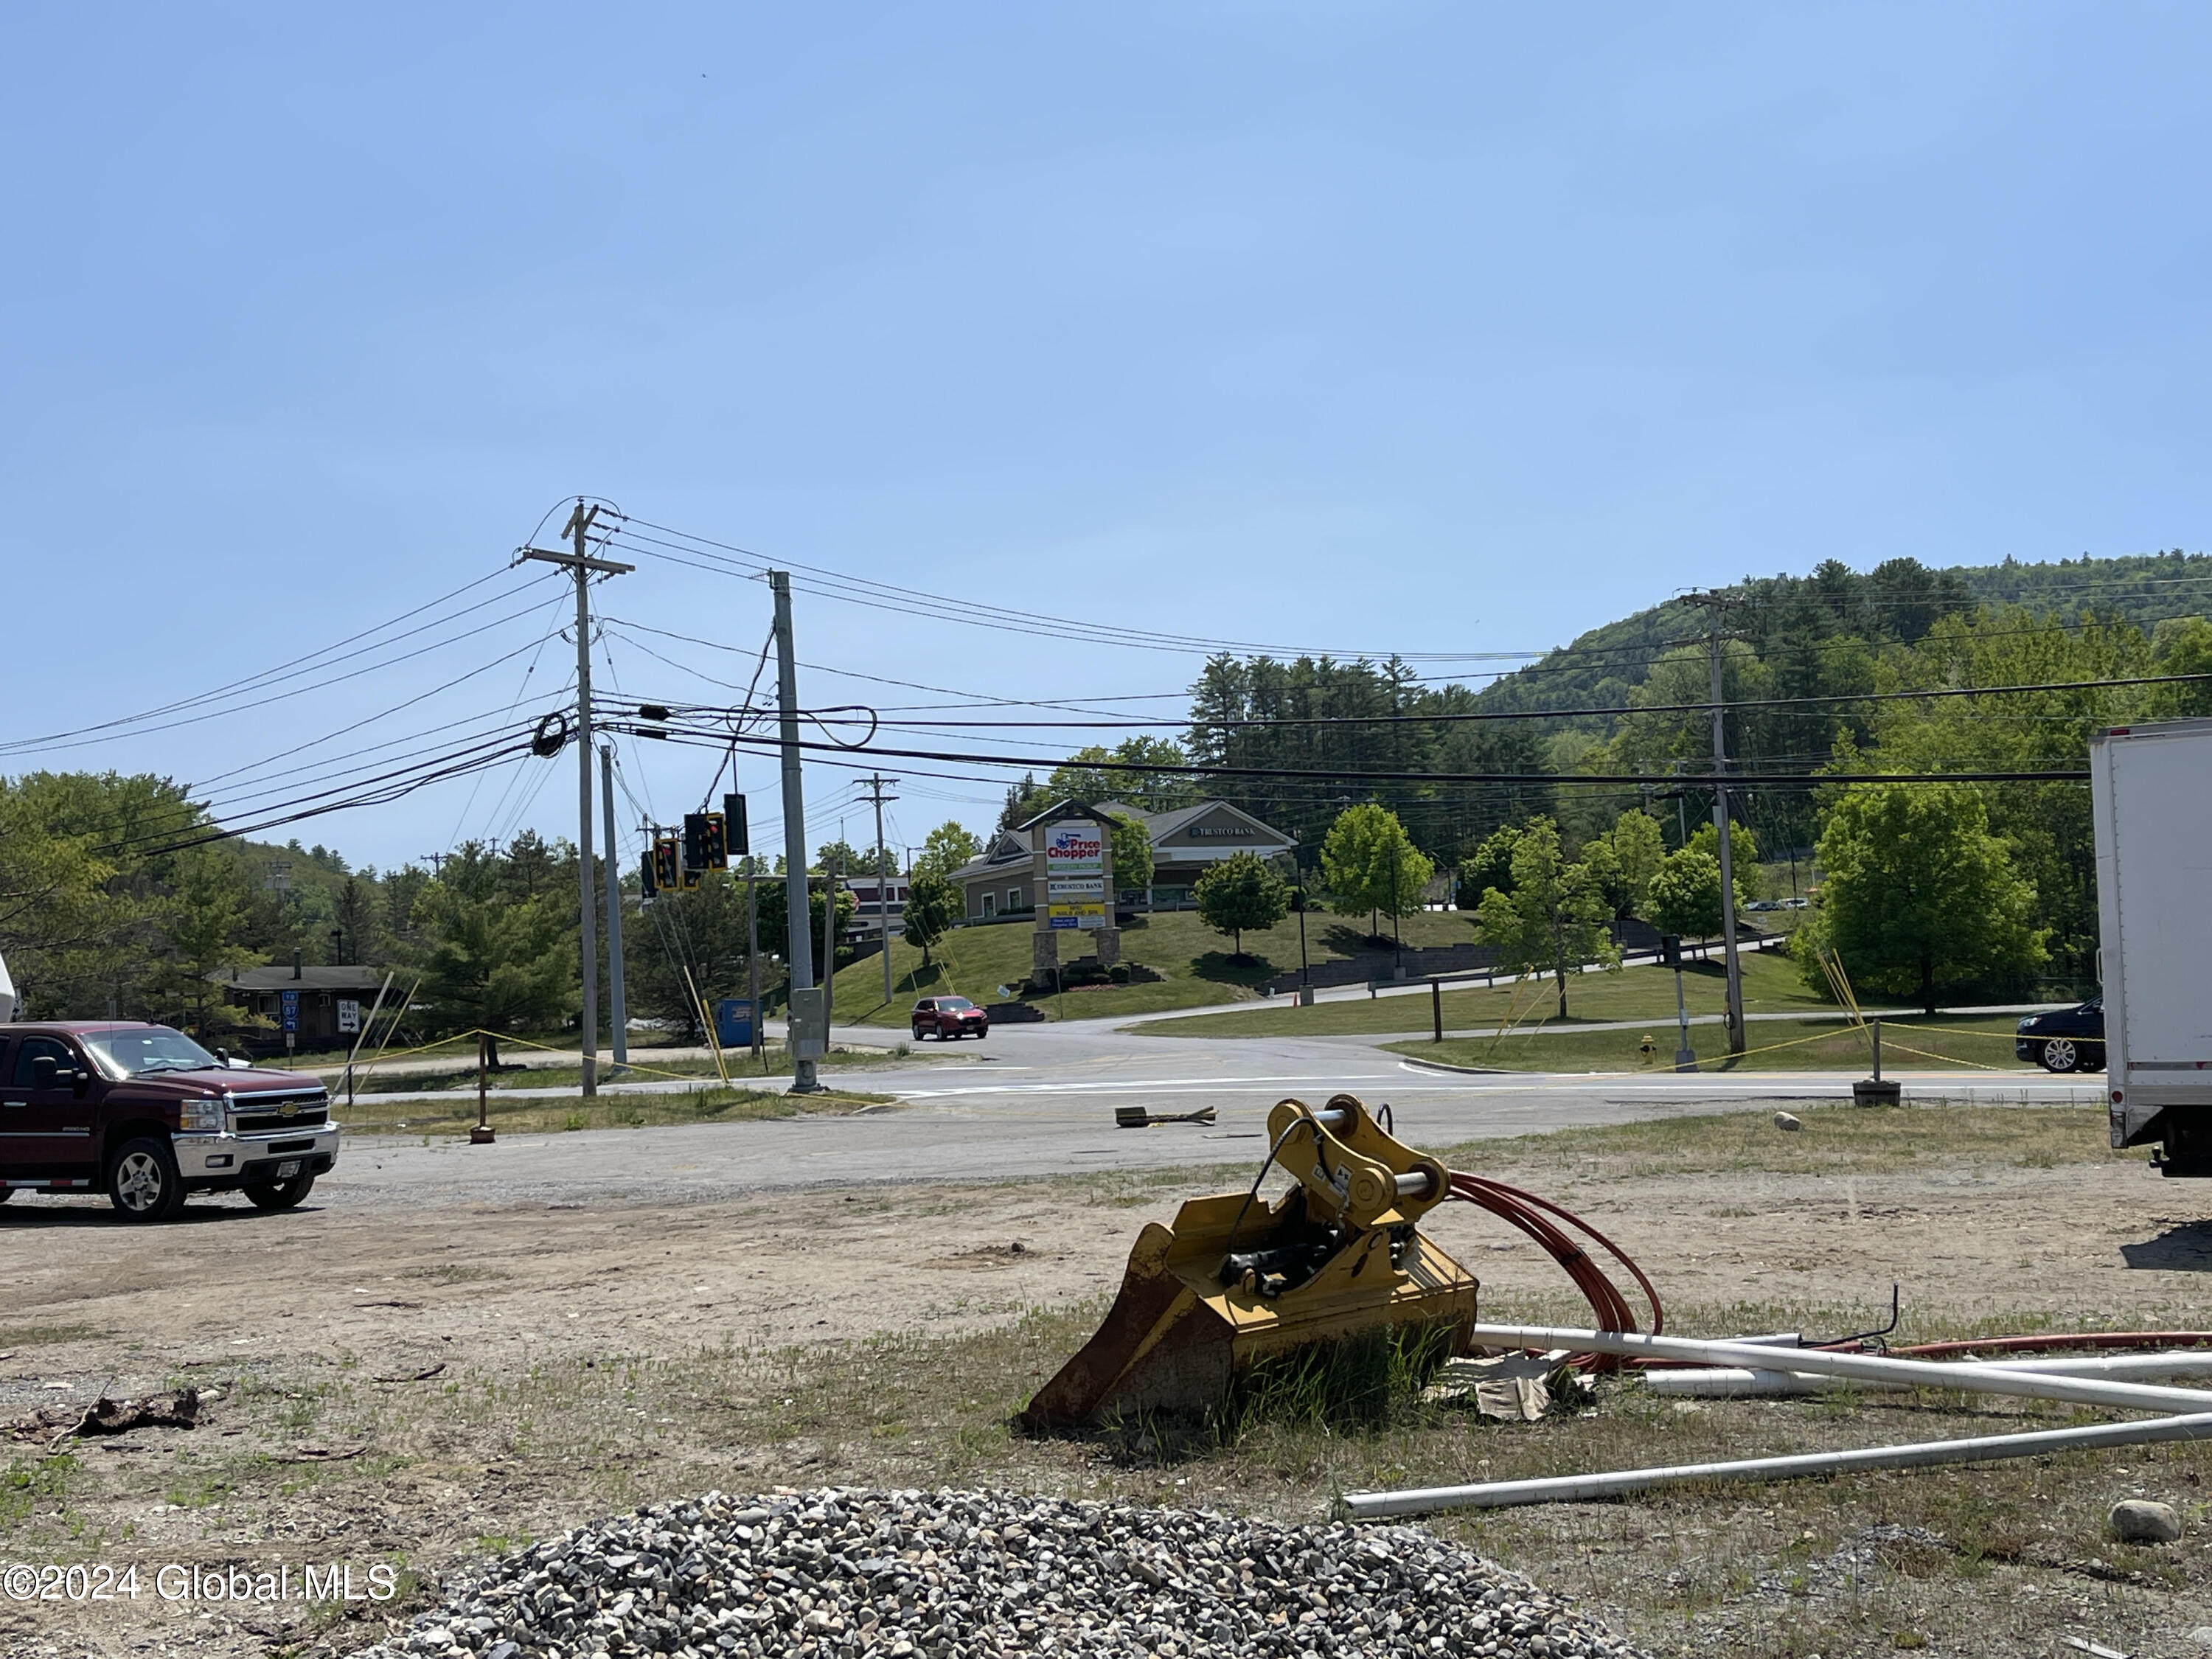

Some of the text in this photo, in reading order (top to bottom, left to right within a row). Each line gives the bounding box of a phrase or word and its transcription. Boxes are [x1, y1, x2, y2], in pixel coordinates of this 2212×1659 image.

[1200, 828, 1233, 836] TRUSTCO
[1070, 838, 1100, 849] Price
[1047, 846, 1100, 860] Chopper
[285, 1006, 296, 1015] 87
[341, 1003, 357, 1011] ONE
